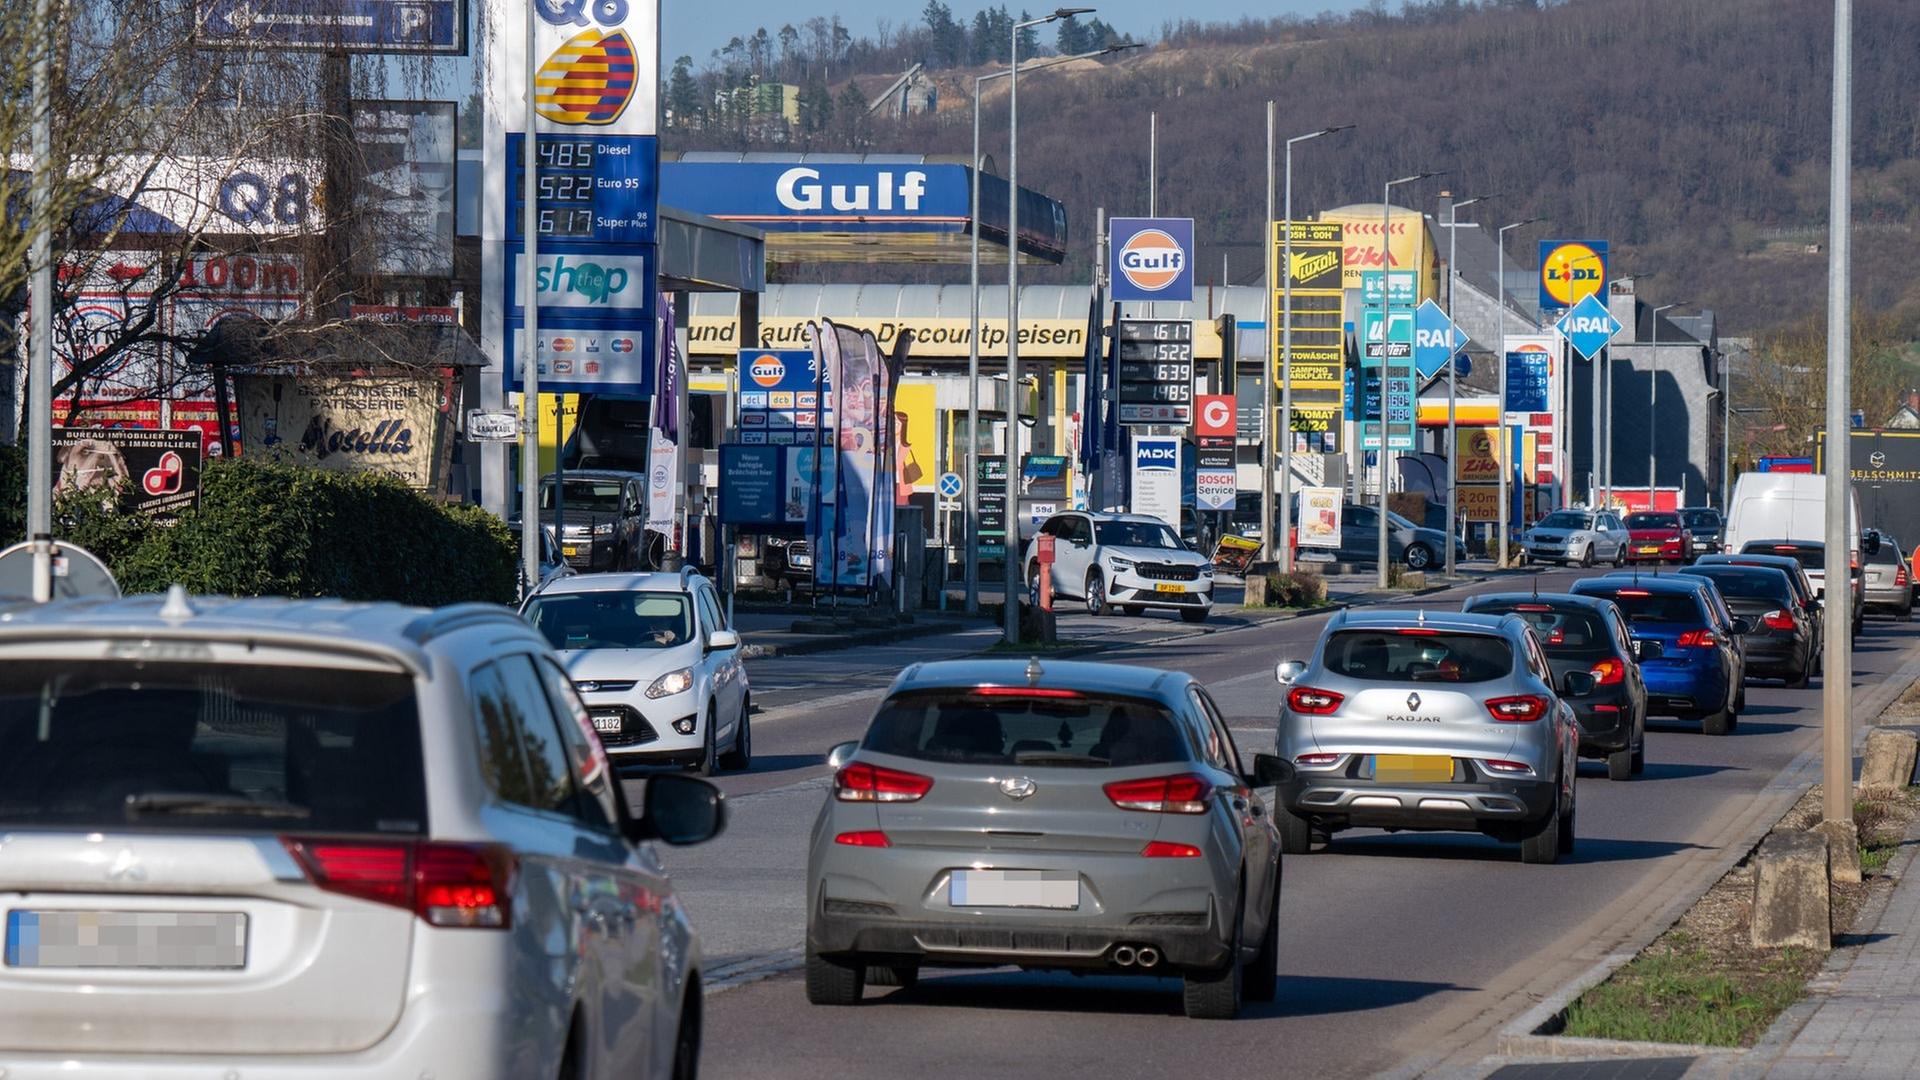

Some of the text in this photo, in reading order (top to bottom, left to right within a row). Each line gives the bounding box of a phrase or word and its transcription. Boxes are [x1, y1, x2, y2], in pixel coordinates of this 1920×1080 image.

[597, 144, 631, 155] Diesel
[597, 178, 622, 190] Euro
[624, 178, 639, 189] 95
[775, 167, 926, 211] Gulf
[637, 212, 648, 220] 98
[597, 216, 648, 229] Super Plus
[1123, 251, 1182, 269] Gulf
[178, 257, 298, 290] 100m
[577, 271, 603, 287] the
[688, 321, 737, 342] und
[752, 366, 784, 376] Gulf
[310, 399, 405, 411] PATISSERIE
[1291, 411, 1335, 419] UTOMAT
[1137, 448, 1175, 459] MDK
[1198, 475, 1234, 485] BOSCH
[1198, 486, 1234, 495] Service
[1386, 714, 1441, 723] KADJAR
